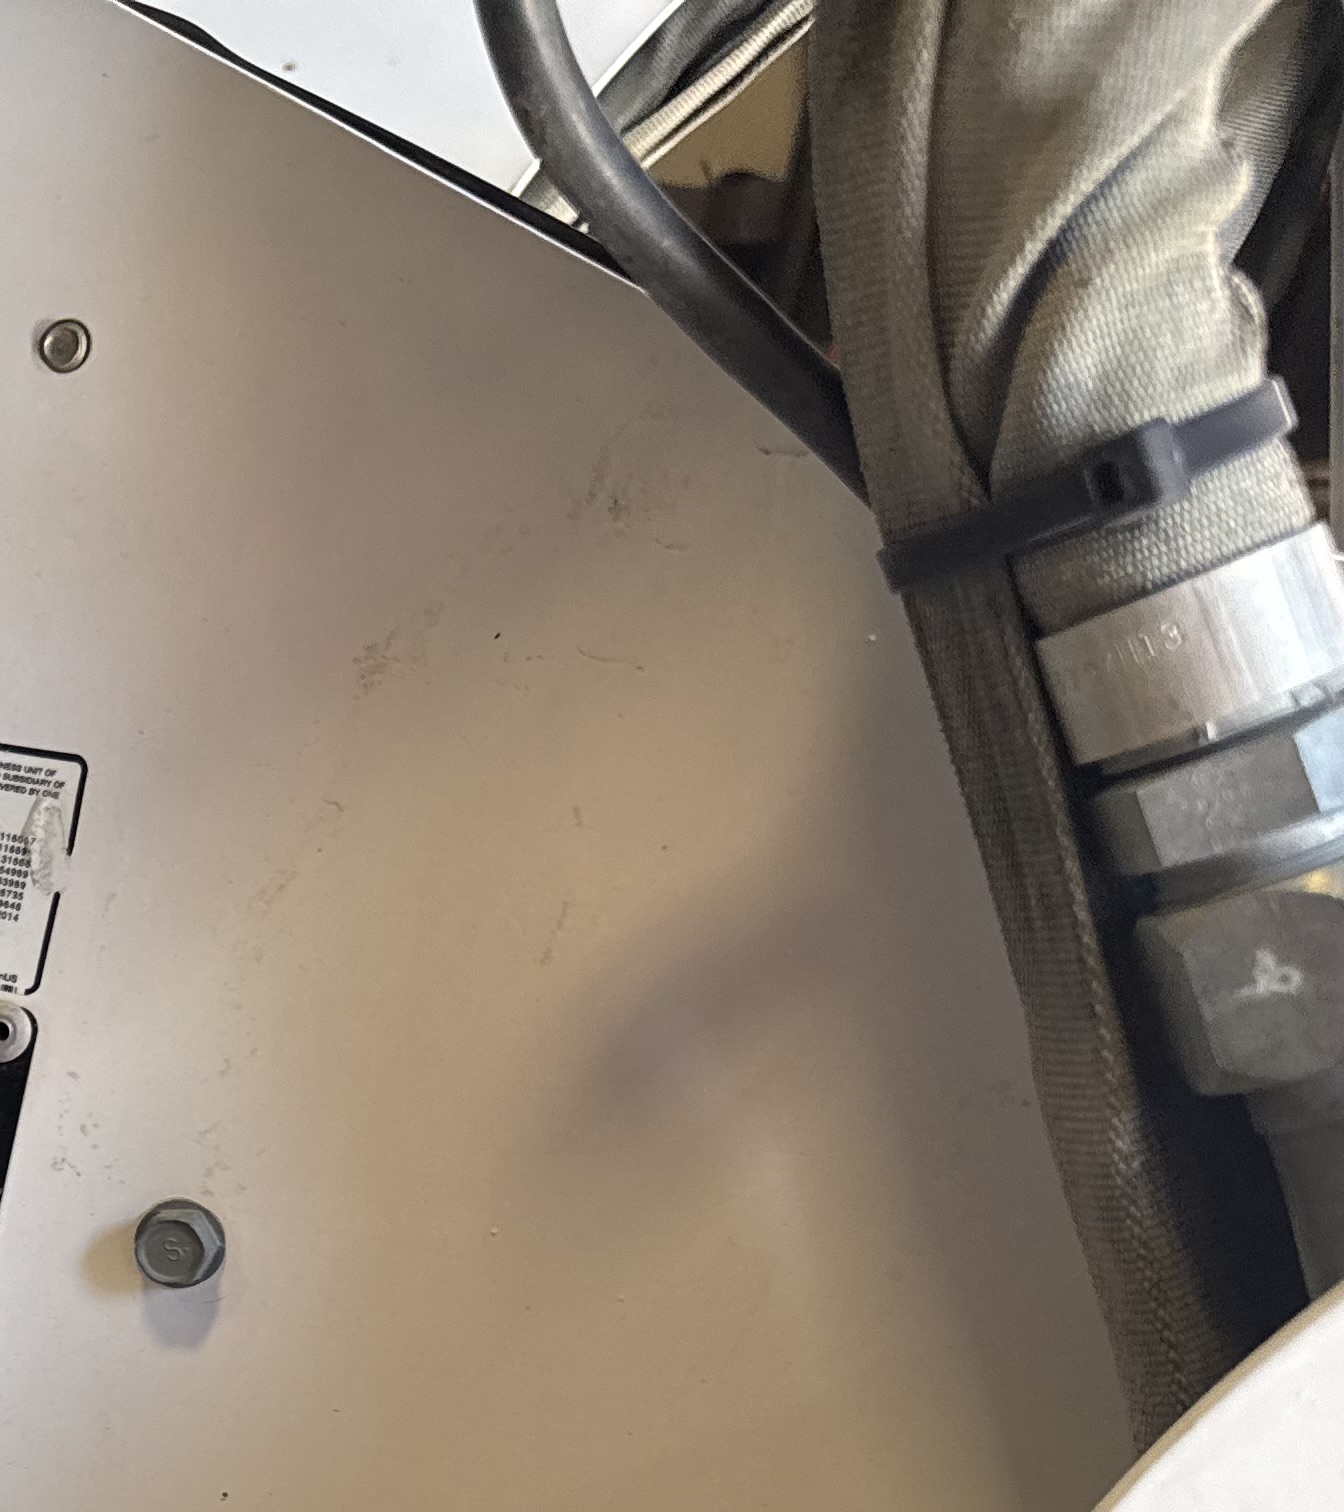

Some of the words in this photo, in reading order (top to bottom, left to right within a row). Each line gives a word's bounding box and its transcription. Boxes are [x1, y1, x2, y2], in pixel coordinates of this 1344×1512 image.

[23, 765, 43, 775] UNIT
[44, 768, 56, 777] OF
[2, 772, 52, 787] SUBSIDIARY
[52, 780, 65, 788] OF
[27, 787, 40, 796] BY
[41, 789, 60, 799] ONE
